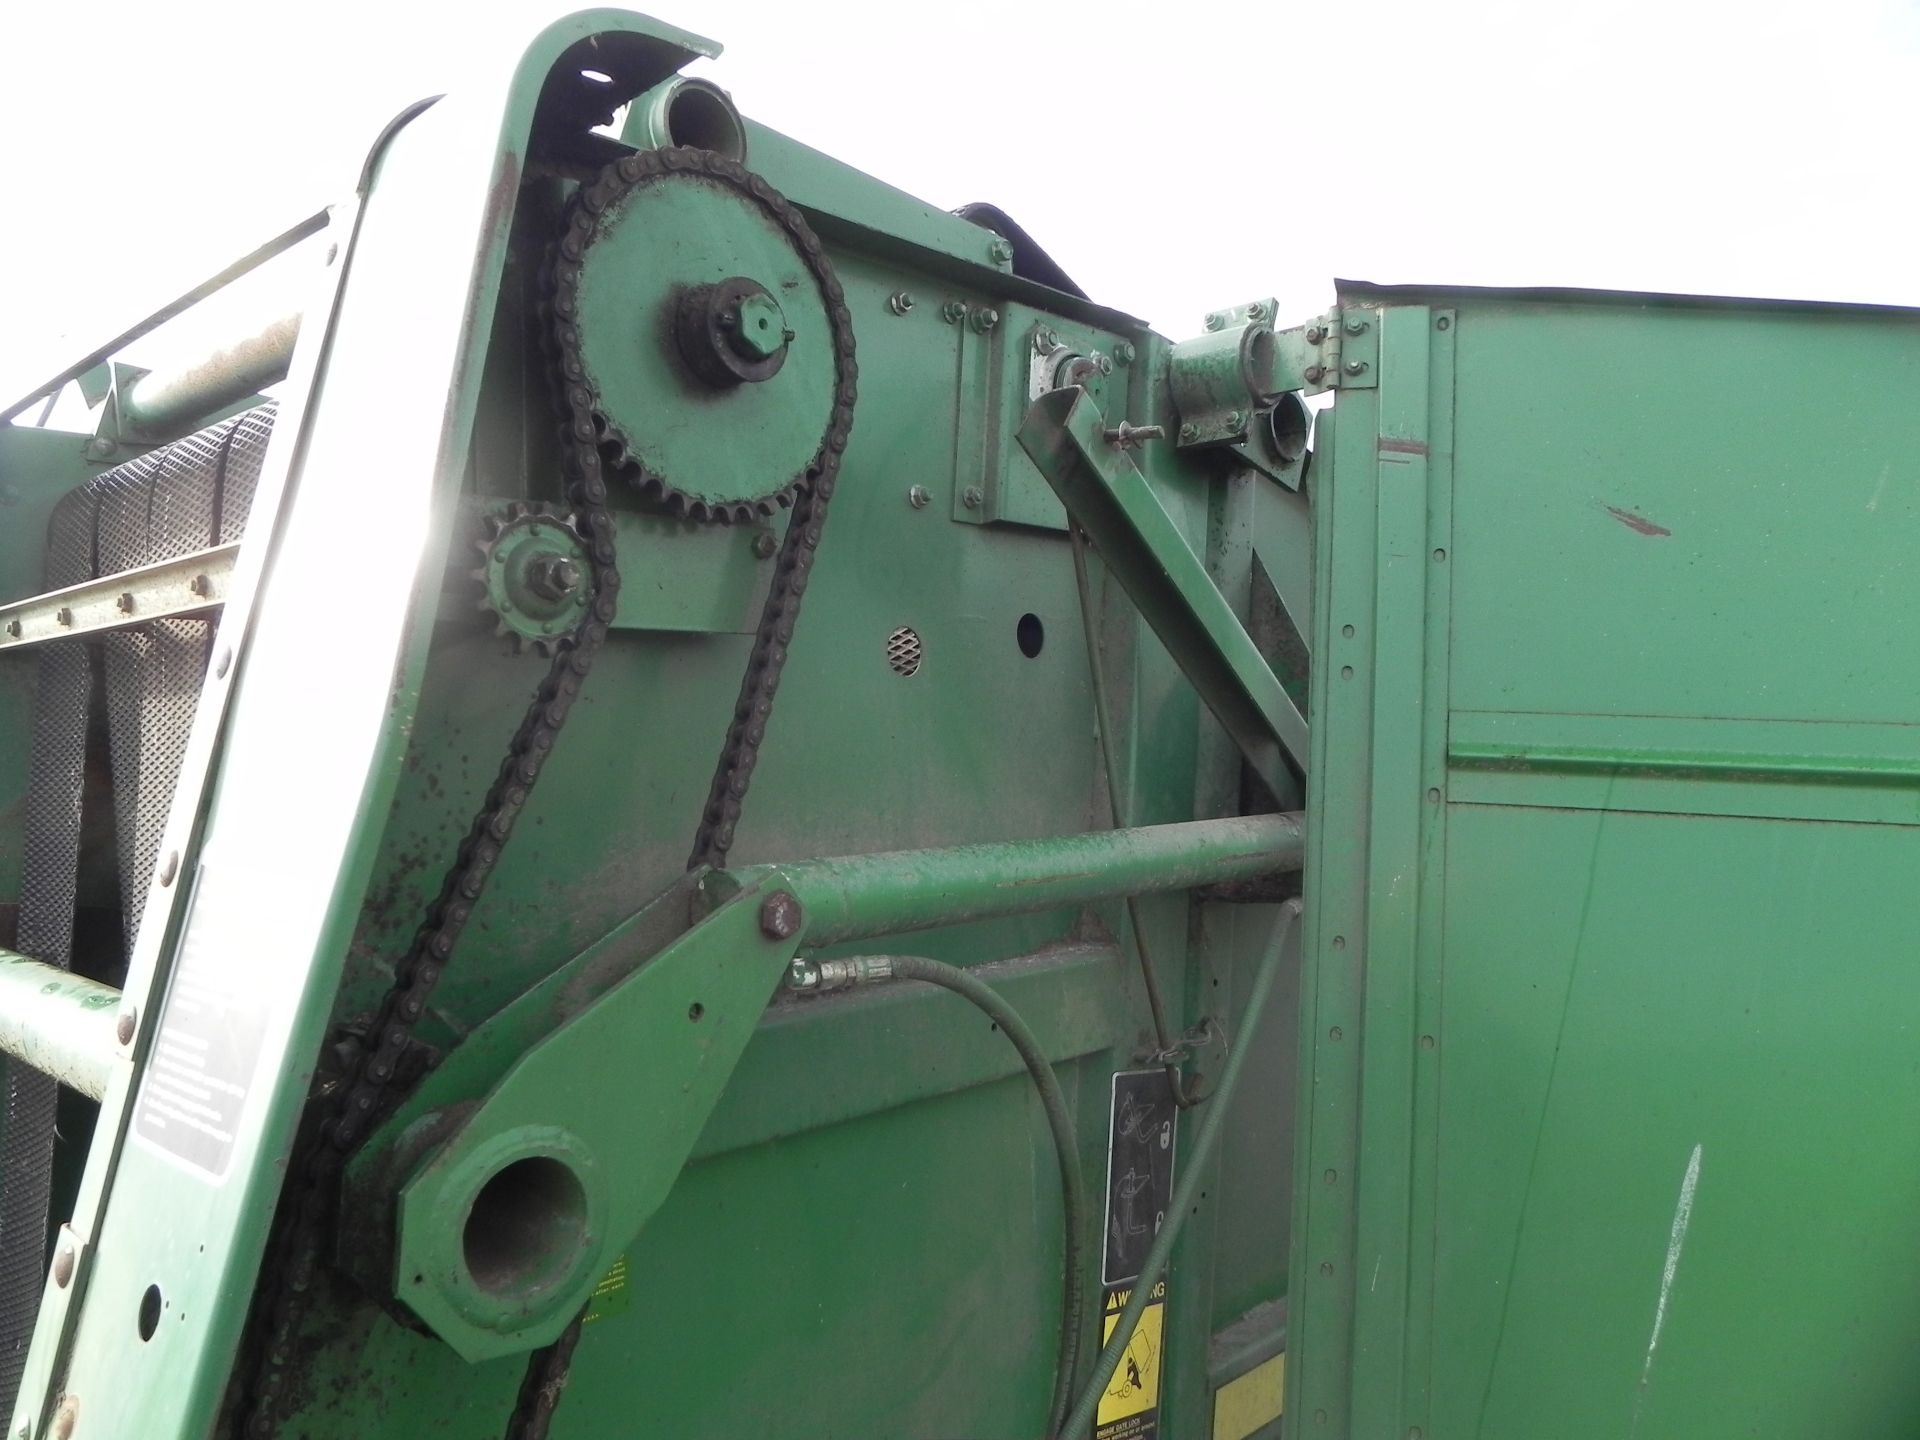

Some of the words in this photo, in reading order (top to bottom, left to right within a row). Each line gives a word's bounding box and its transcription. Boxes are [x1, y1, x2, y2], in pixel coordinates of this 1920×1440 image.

[1097, 1427, 1114, 1440] ENGAGE
[1115, 1422, 1128, 1432] GATE
[1129, 1417, 1141, 1428] LOCK
